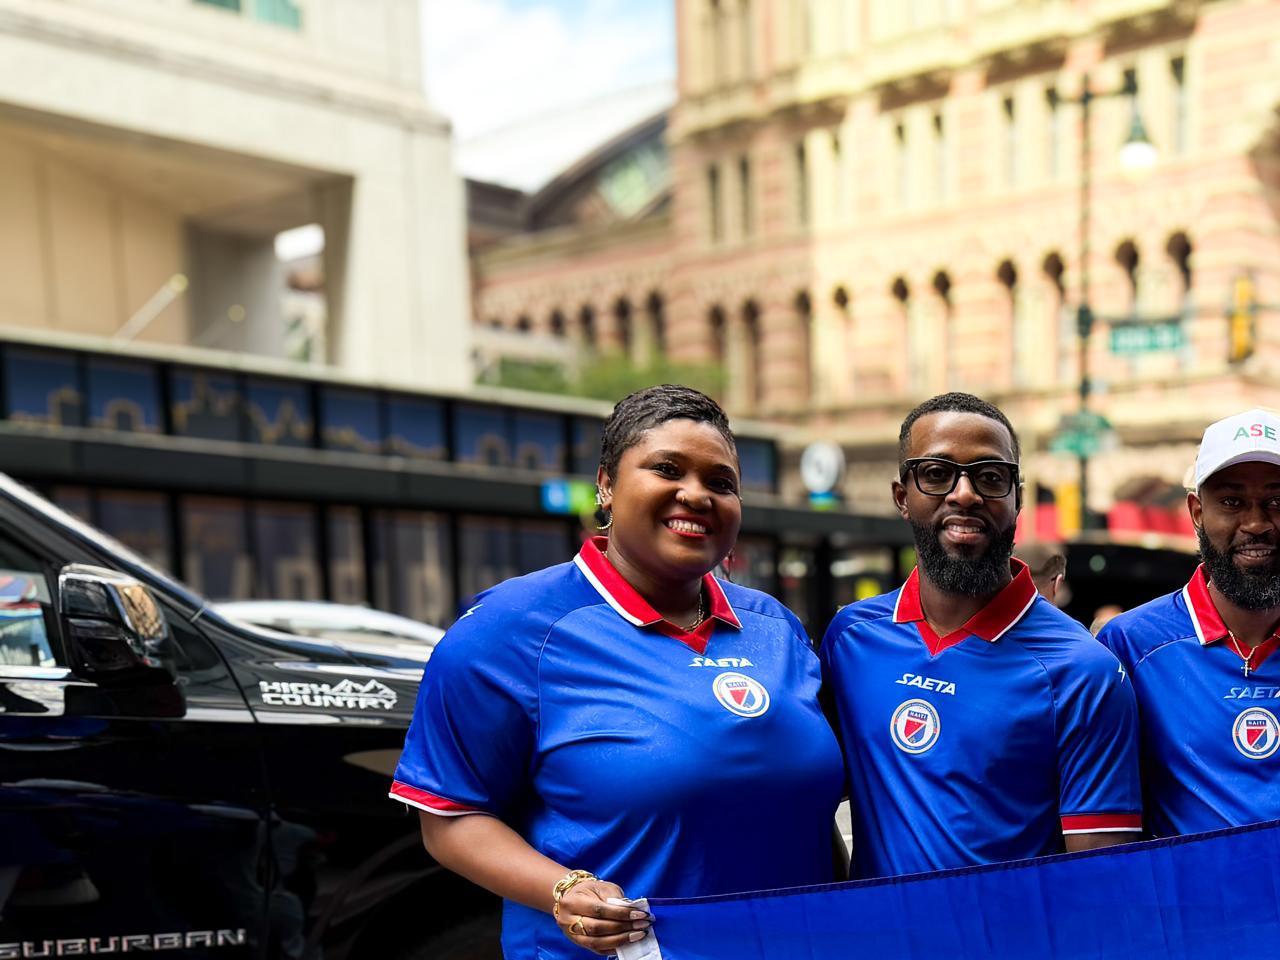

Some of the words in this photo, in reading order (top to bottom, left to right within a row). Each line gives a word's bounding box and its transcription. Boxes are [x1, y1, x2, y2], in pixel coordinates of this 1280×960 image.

[1232, 423, 1277, 441] ASE
[688, 656, 754, 668] SAETA
[259, 681, 332, 695] HIGH
[895, 673, 956, 695] SAETA
[262, 693, 397, 709] COUNTRY
[0, 928, 246, 960] SUBURBAN
